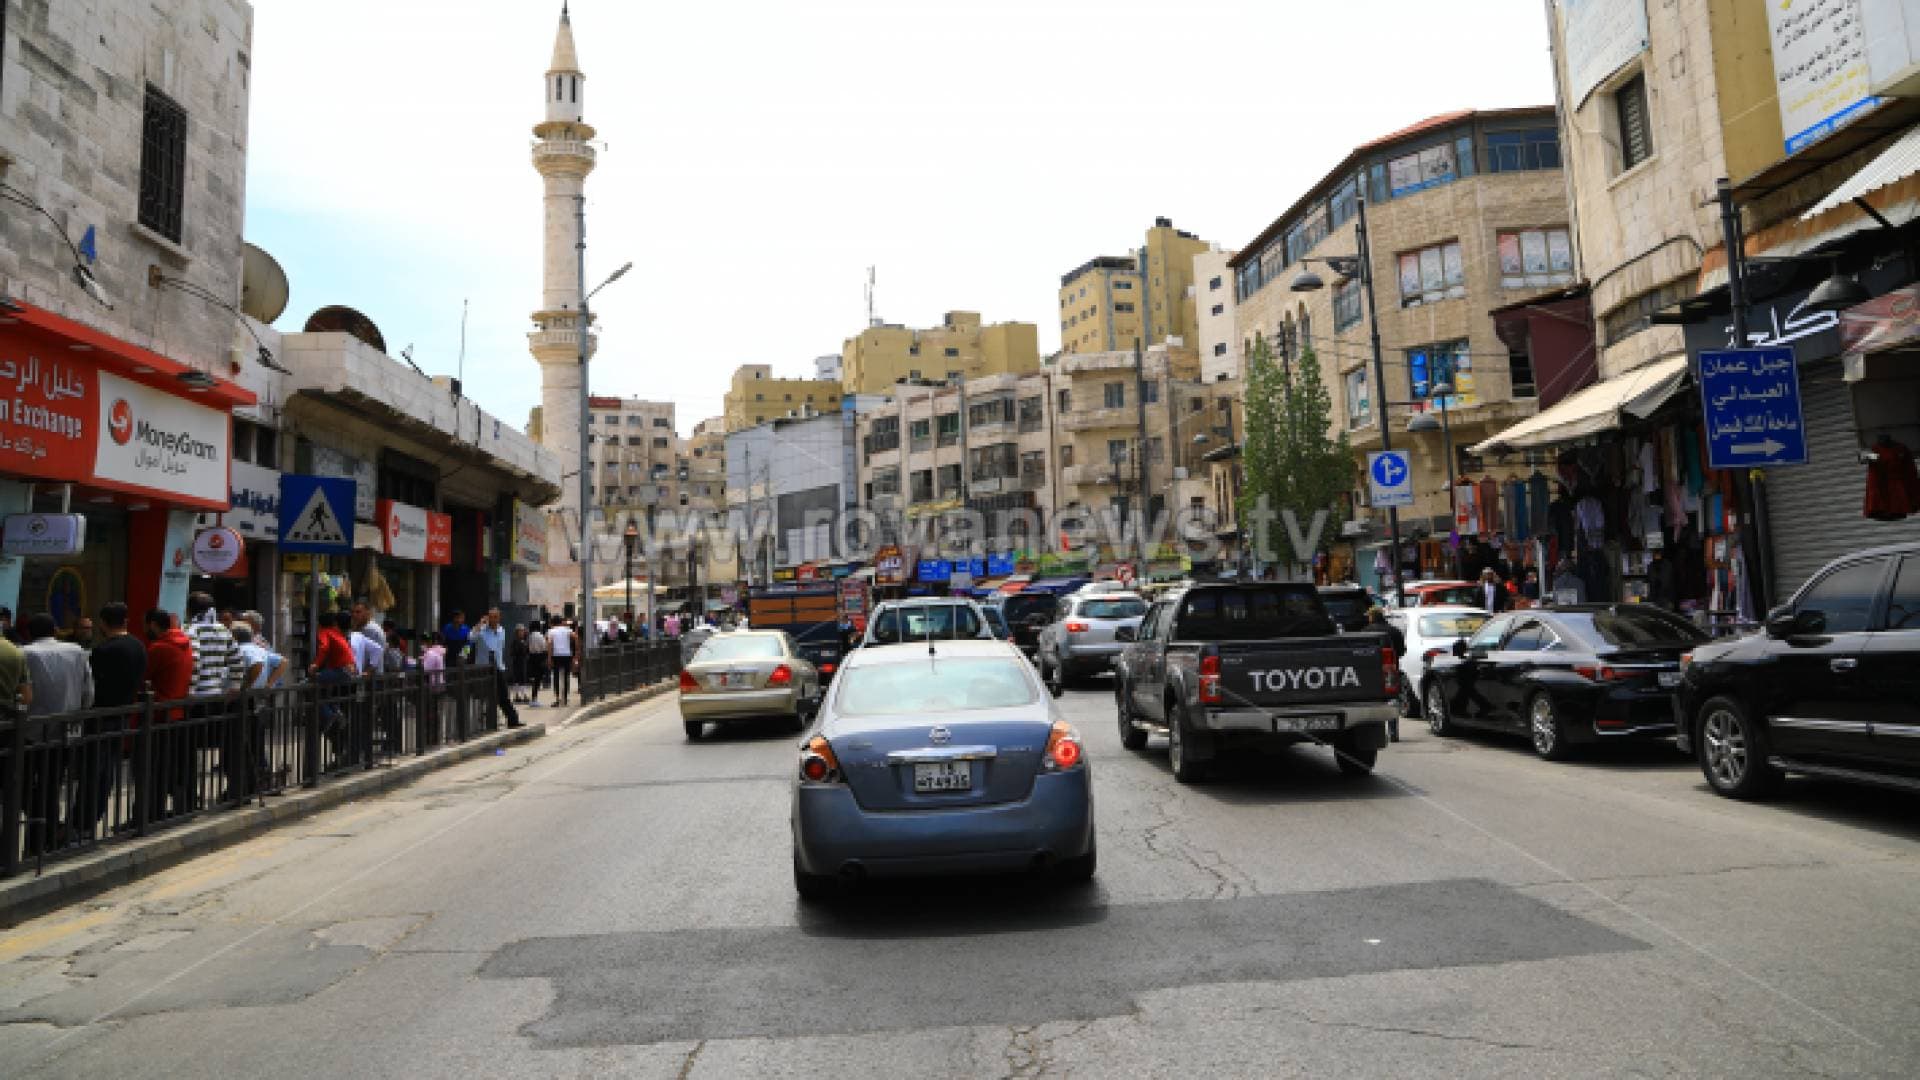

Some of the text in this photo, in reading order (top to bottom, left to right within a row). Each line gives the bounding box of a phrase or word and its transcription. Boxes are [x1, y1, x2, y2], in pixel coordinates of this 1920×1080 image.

[1703, 354, 1792, 377] جبل عمان
[13, 397, 82, 439] Exchange
[136, 418, 218, 461] MoneyGram
[1248, 666, 1361, 692] TOYOTA
